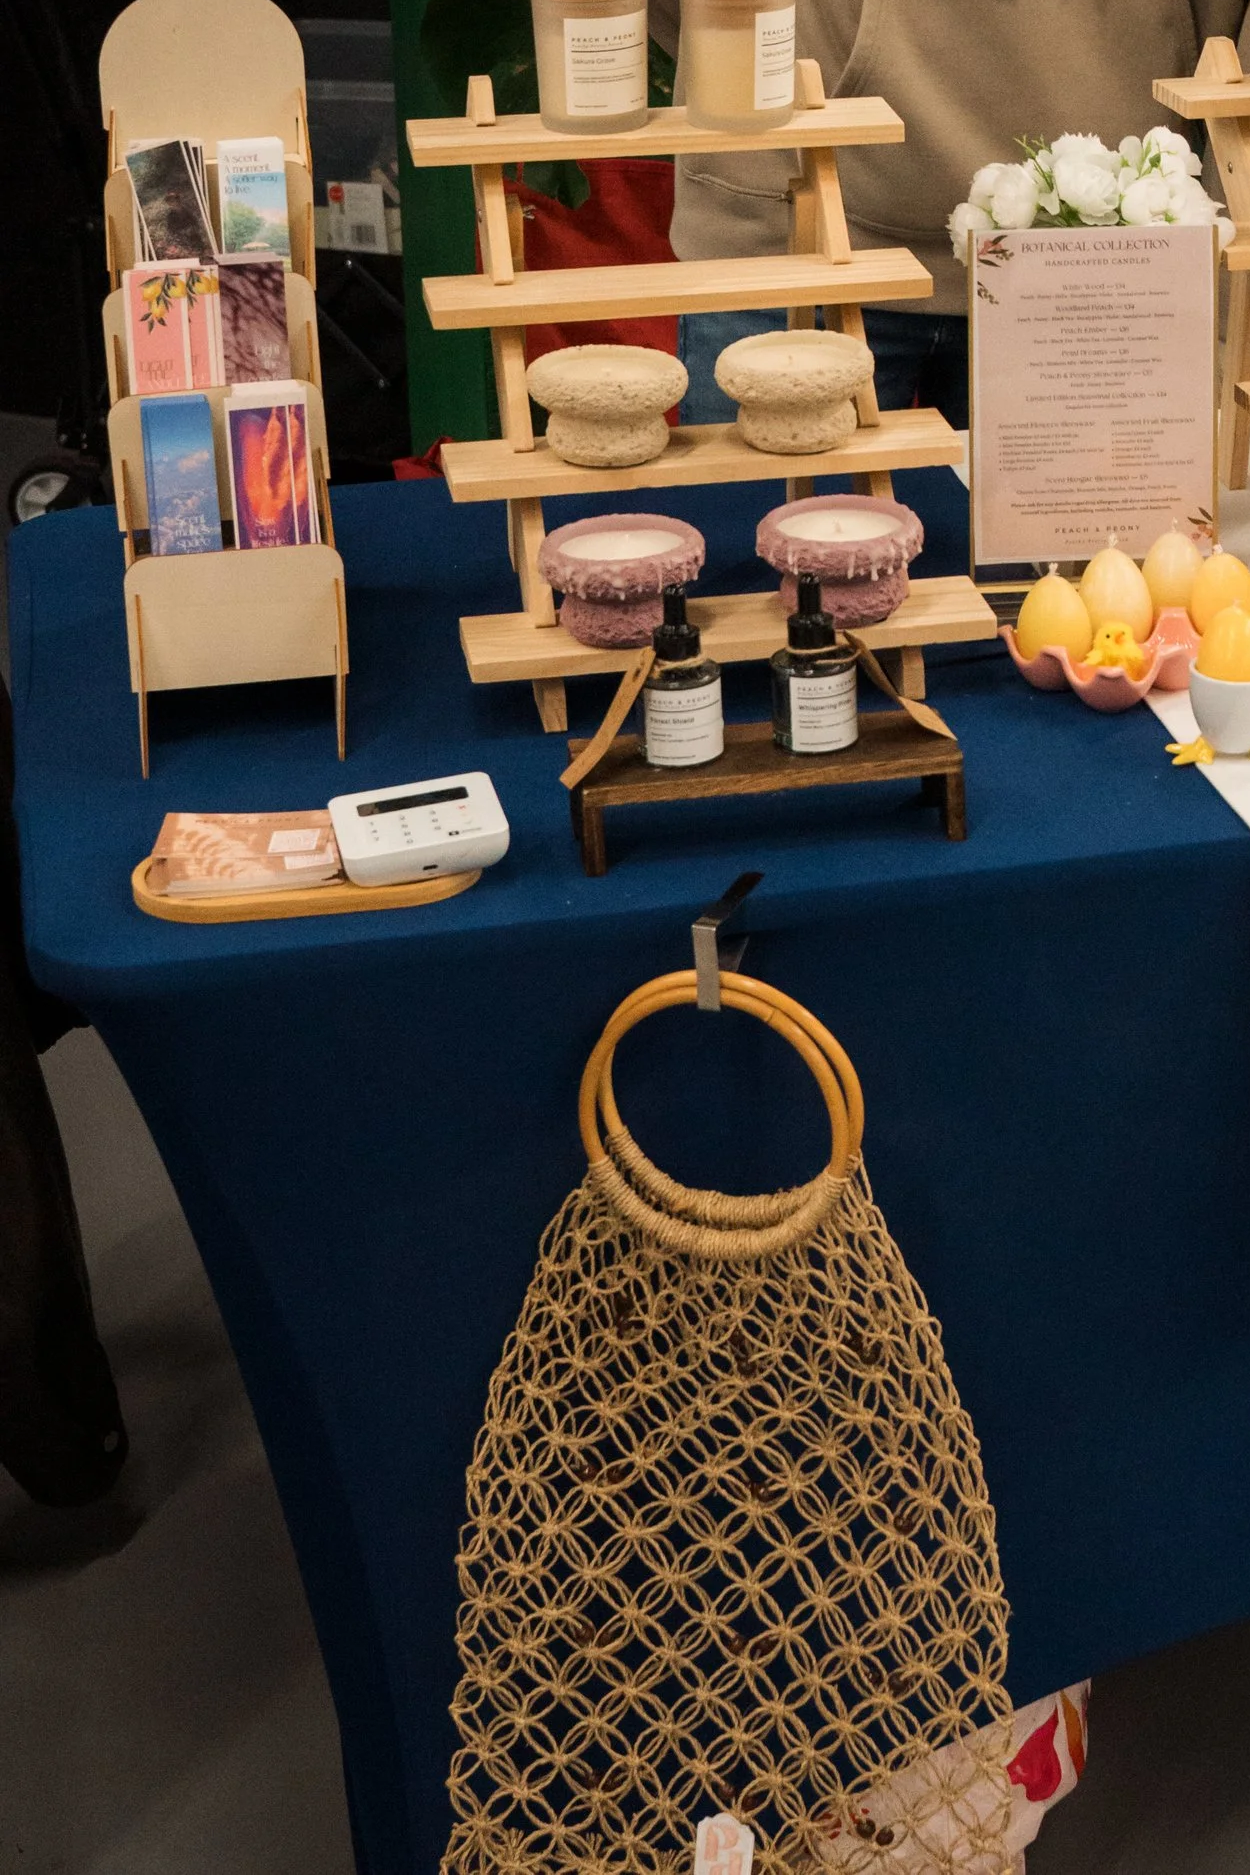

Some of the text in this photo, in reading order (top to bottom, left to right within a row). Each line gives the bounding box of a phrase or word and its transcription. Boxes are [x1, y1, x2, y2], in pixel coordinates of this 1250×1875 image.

[571, 57, 616, 65] Sakura Grove
[1020, 238, 1170, 254] BOTANICAL COLLECTION
[1044, 256, 1152, 268] HANDCRAFTED CANDLES
[1055, 303, 1090, 313] Woodland
[1054, 526, 1090, 535] PEACH
[1106, 525, 1141, 533] PEONY
